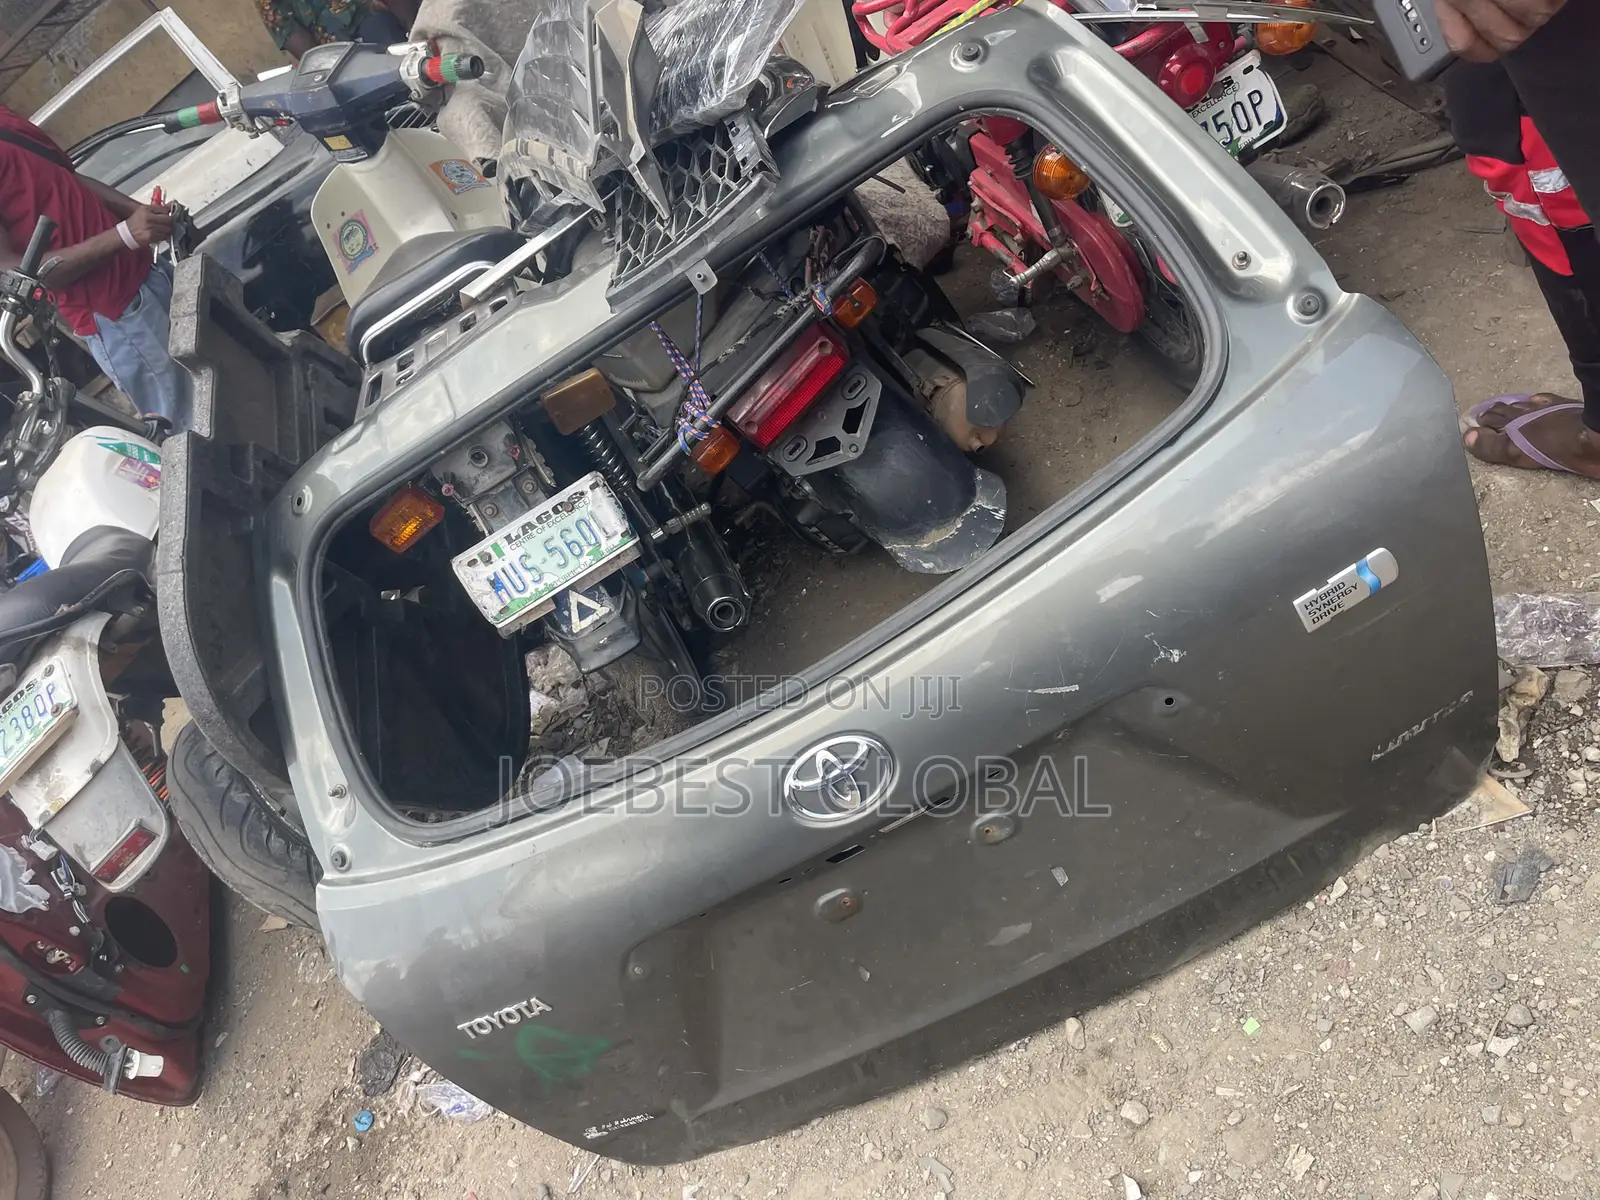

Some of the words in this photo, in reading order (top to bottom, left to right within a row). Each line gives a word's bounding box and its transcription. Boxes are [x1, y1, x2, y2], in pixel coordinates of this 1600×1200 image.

[503, 491, 589, 545] LAGOS
[509, 532, 537, 551] CENTRE
[536, 525, 549, 537] OF
[1304, 581, 1346, 610] HYBRID
[1308, 583, 1358, 617] SYNERGY
[1311, 601, 1345, 624] DRIVE
[457, 996, 553, 1040] TOYOTA
